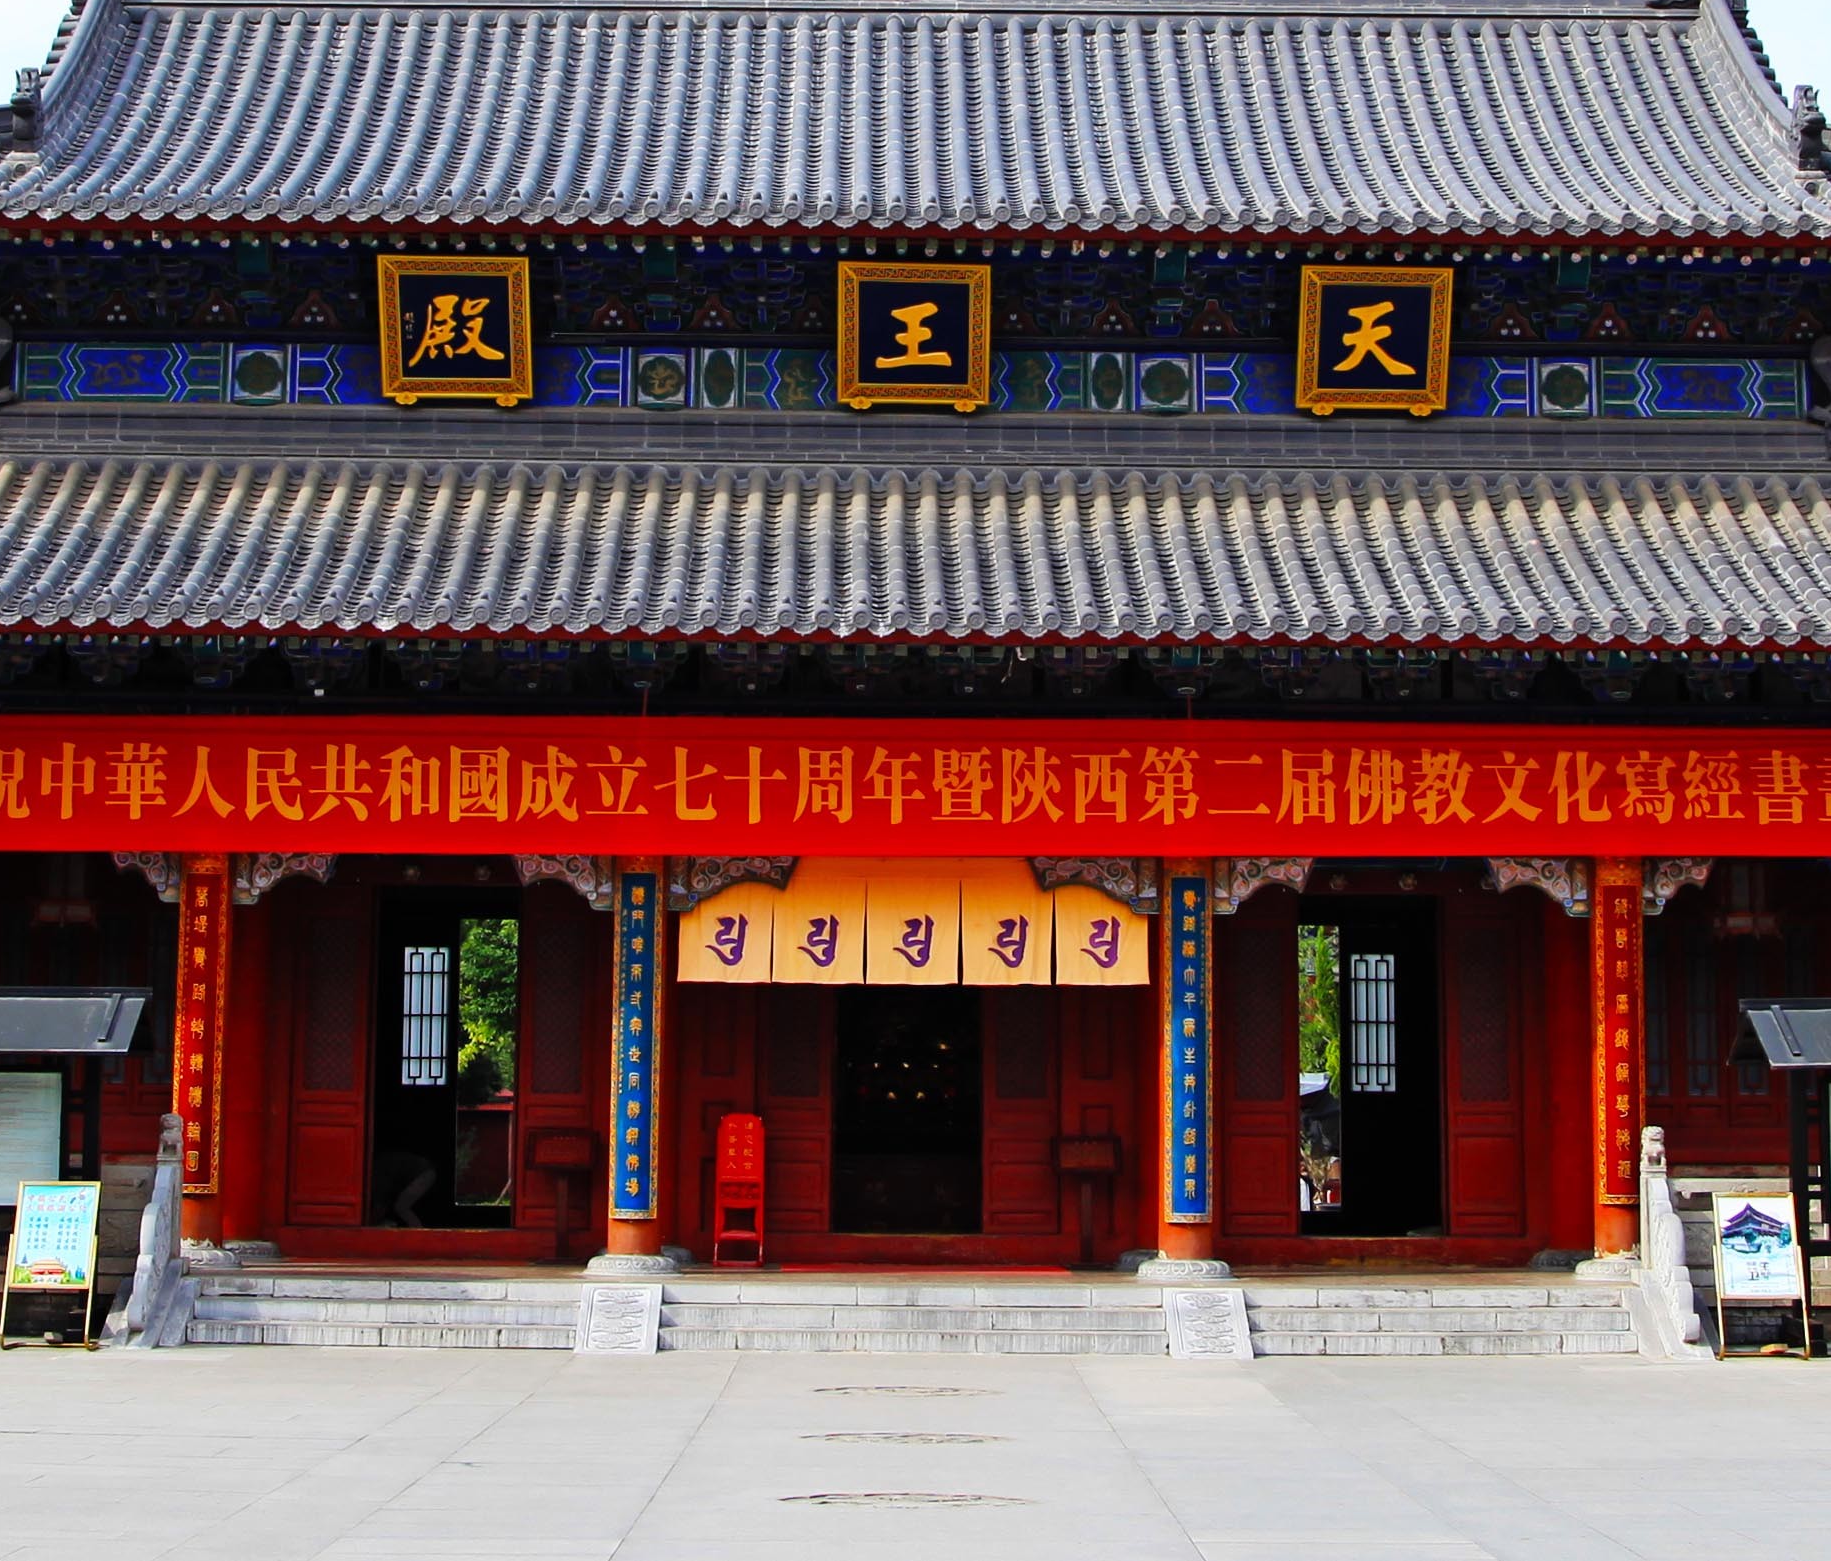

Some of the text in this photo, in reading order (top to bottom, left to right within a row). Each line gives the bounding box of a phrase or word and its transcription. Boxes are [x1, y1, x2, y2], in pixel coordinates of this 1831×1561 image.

[409, 295, 1416, 375] 天 王 殿
